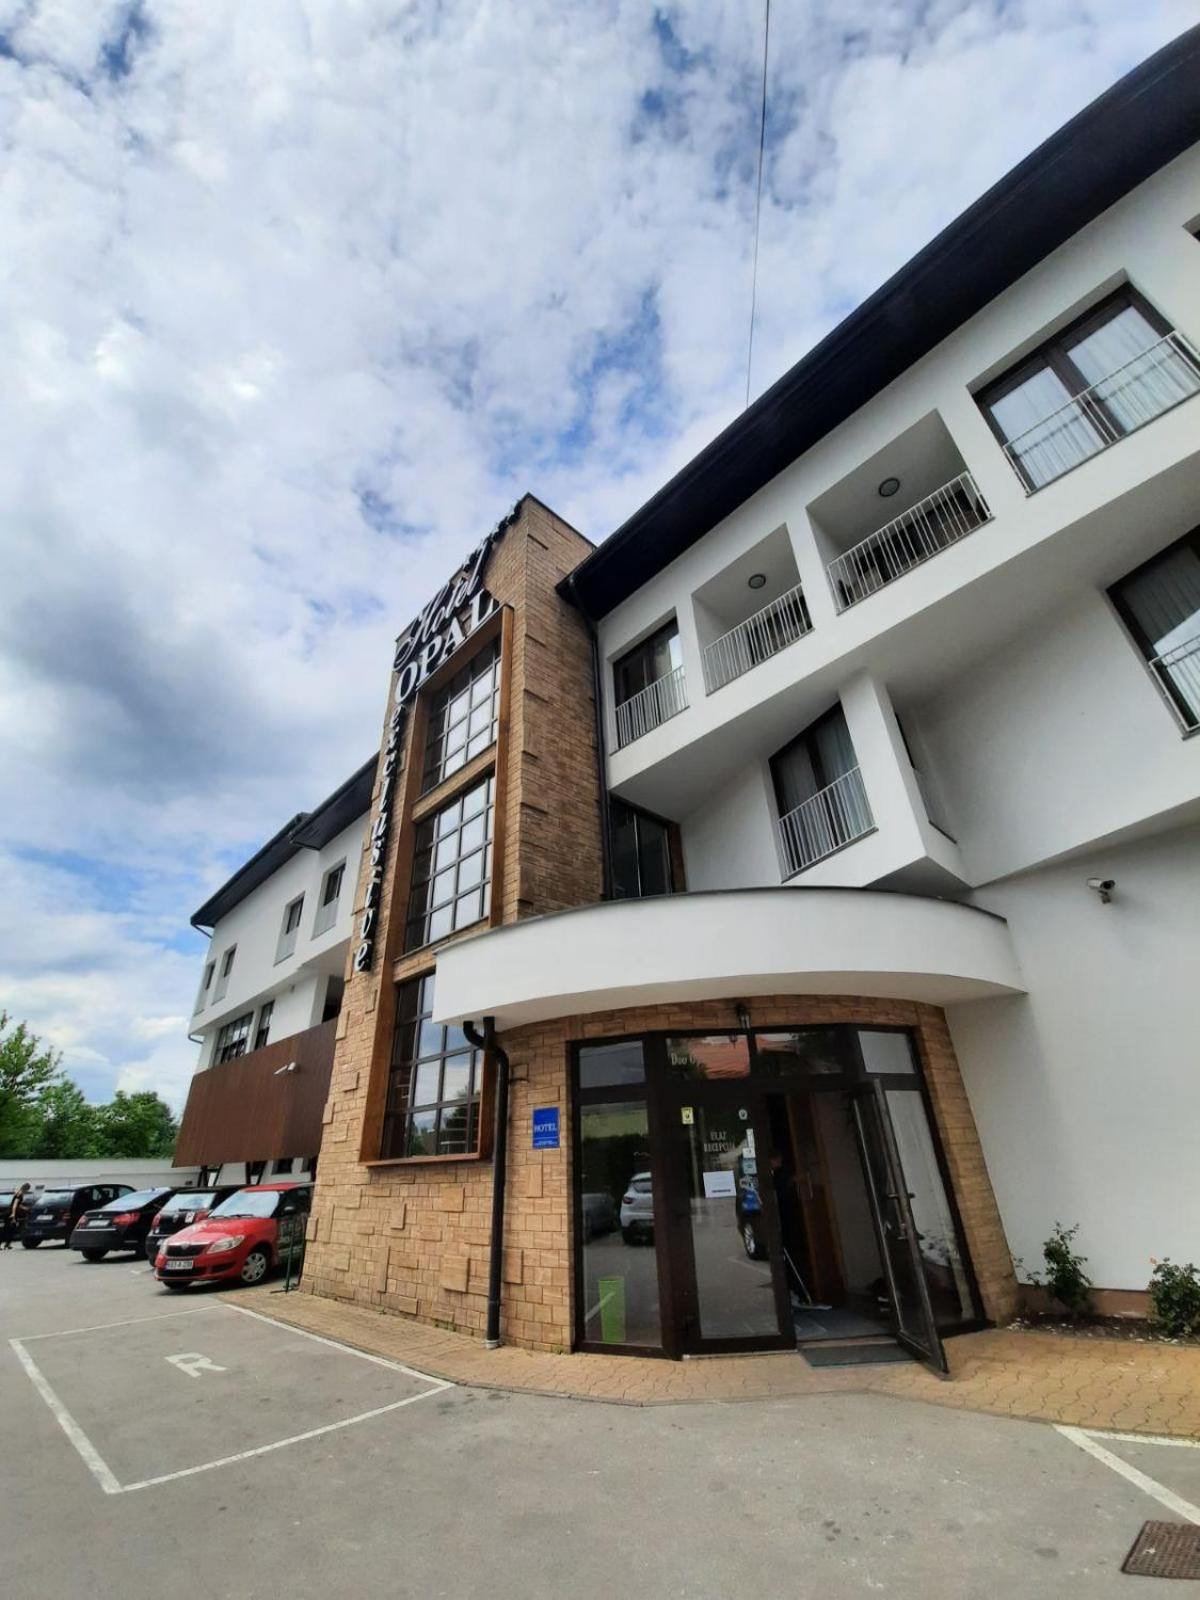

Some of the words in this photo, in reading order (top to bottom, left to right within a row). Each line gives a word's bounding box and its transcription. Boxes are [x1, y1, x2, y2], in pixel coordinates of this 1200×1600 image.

[393, 540, 490, 672] Hotel
[394, 588, 498, 704] OPAL
[533, 1122, 558, 1133] HOTEL
[163, 1352, 228, 1378] R
